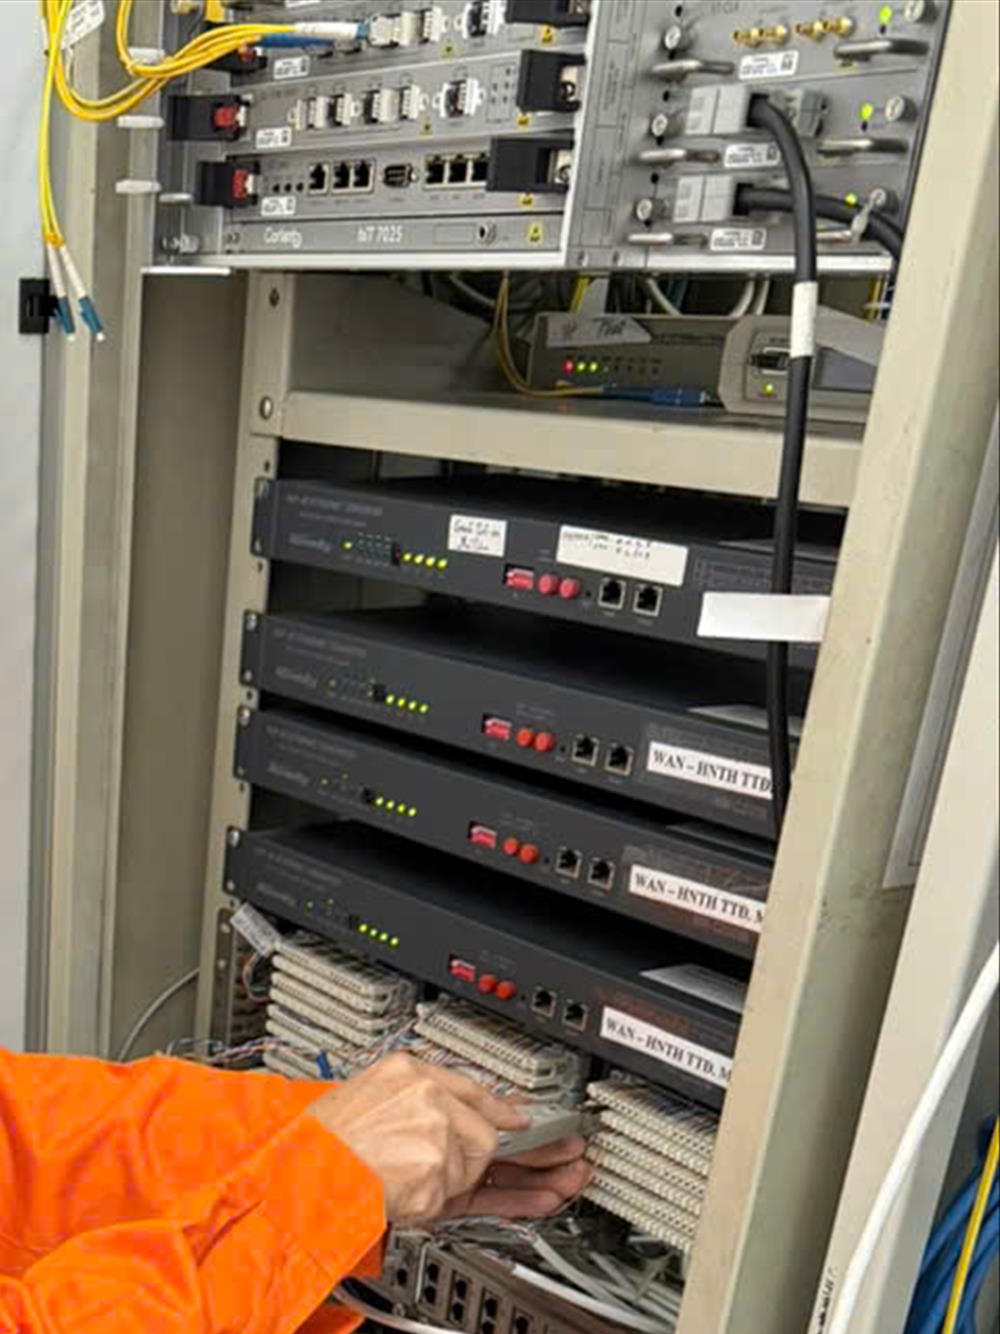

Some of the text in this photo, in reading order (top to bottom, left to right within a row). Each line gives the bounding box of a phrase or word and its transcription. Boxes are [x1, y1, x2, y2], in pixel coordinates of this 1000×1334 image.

[653, 749, 685, 769] WAN
[696, 761, 738, 784] HNTH
[635, 872, 665, 894] WAN
[677, 886, 717, 910] HNTH
[606, 1017, 635, 1041] WAN
[646, 1034, 684, 1062] HNTH
